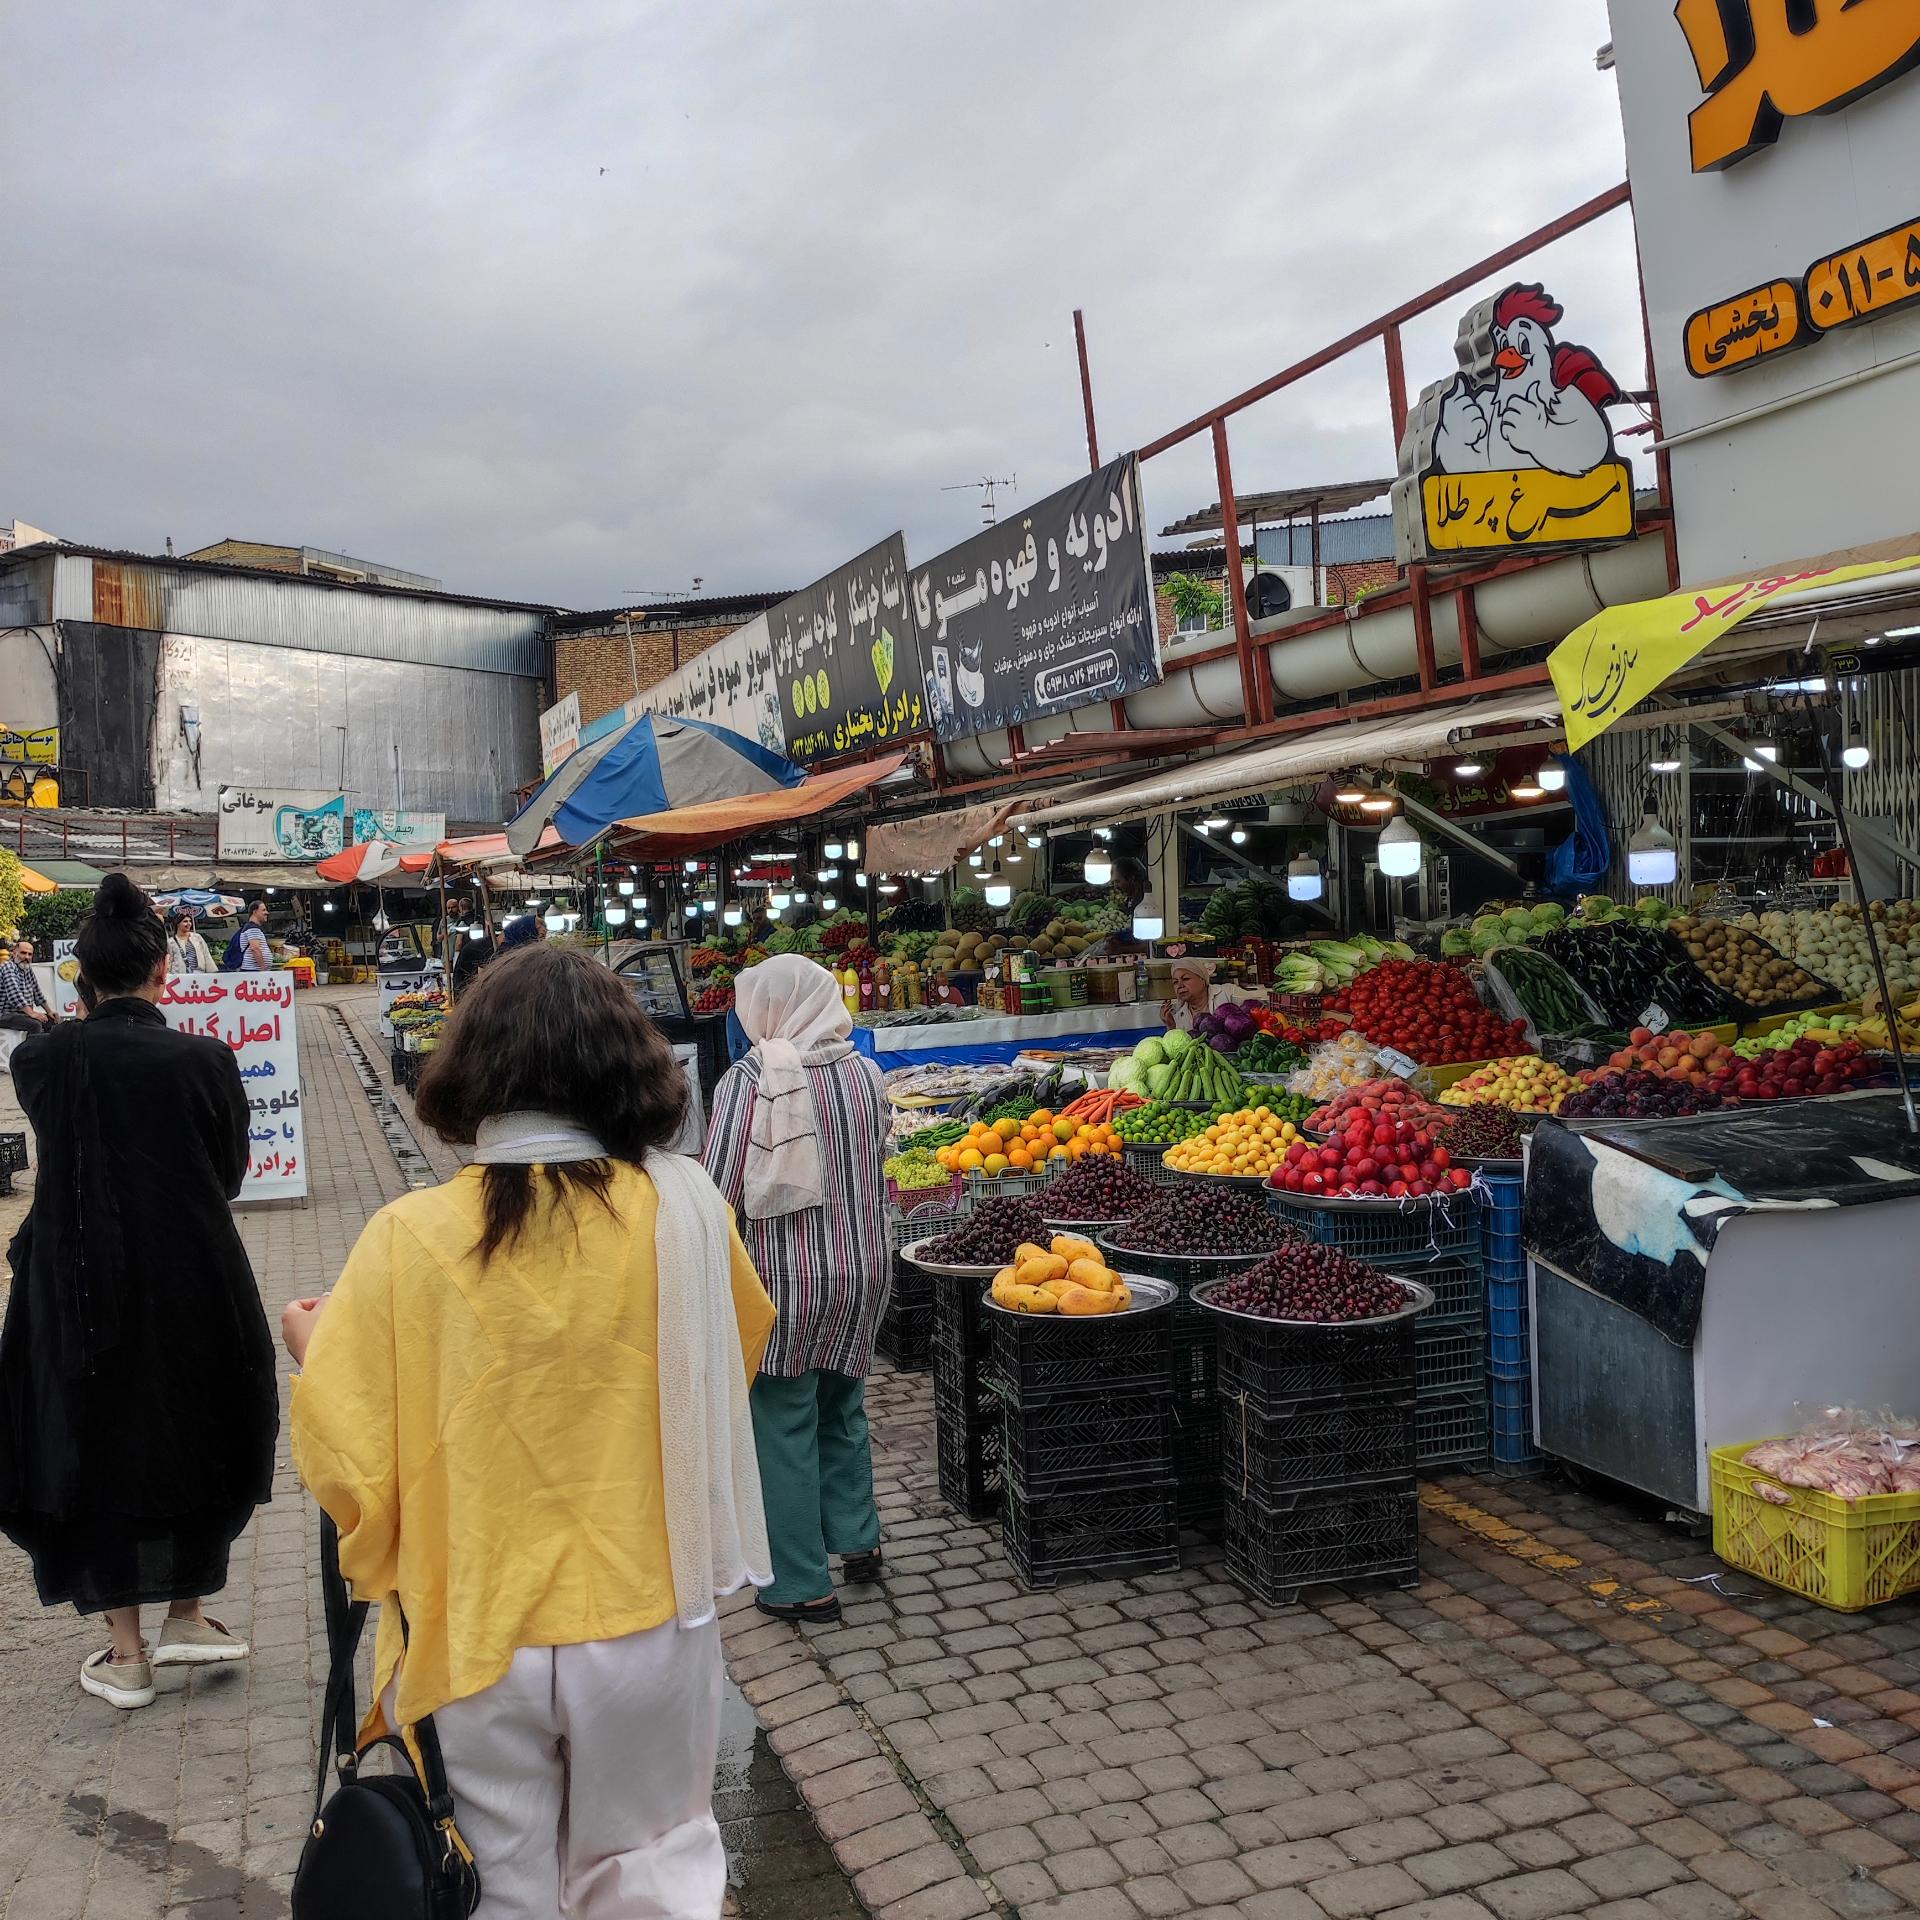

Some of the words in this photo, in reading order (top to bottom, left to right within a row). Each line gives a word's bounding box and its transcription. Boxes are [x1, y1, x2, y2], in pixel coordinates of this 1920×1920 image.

[1704, 299, 1779, 364] بخشی
[1065, 466, 1133, 574] ادویه
[1437, 480, 1470, 528] طلا
[1473, 495, 1498, 533] پر
[1505, 472, 1621, 541] مرغ
[990, 516, 1038, 611] قهوه
[1047, 537, 1061, 593] و
[881, 555, 908, 621] رشته
[912, 567, 989, 642] موکا
[813, 590, 838, 660] کلوچه
[847, 568, 880, 646] خوشکار
[1043, 610, 1060, 633] ادویه
[1109, 612, 1125, 639] انواع
[1021, 619, 1037, 641] قهوه
[1037, 620, 1042, 636] و
[746, 645, 772, 697] سوپر
[1038, 648, 1043, 662] و
[717, 660, 742, 707] میوه
[1046, 674, 1069, 694] ۰۹۳۸
[833, 704, 874, 751] بختیاری
[877, 689, 922, 738] برادران
[222, 792, 274, 814] سوغاتی
[394, 825, 415, 837] رحیم
[56, 942, 74, 960] کار
[158, 977, 228, 1005] خشک
[234, 977, 293, 1009] رشته
[226, 1014, 281, 1051] اصل
[239, 1060, 276, 1084] همی
[283, 1121, 296, 1145] با
[246, 1151, 297, 1178] برادرا
